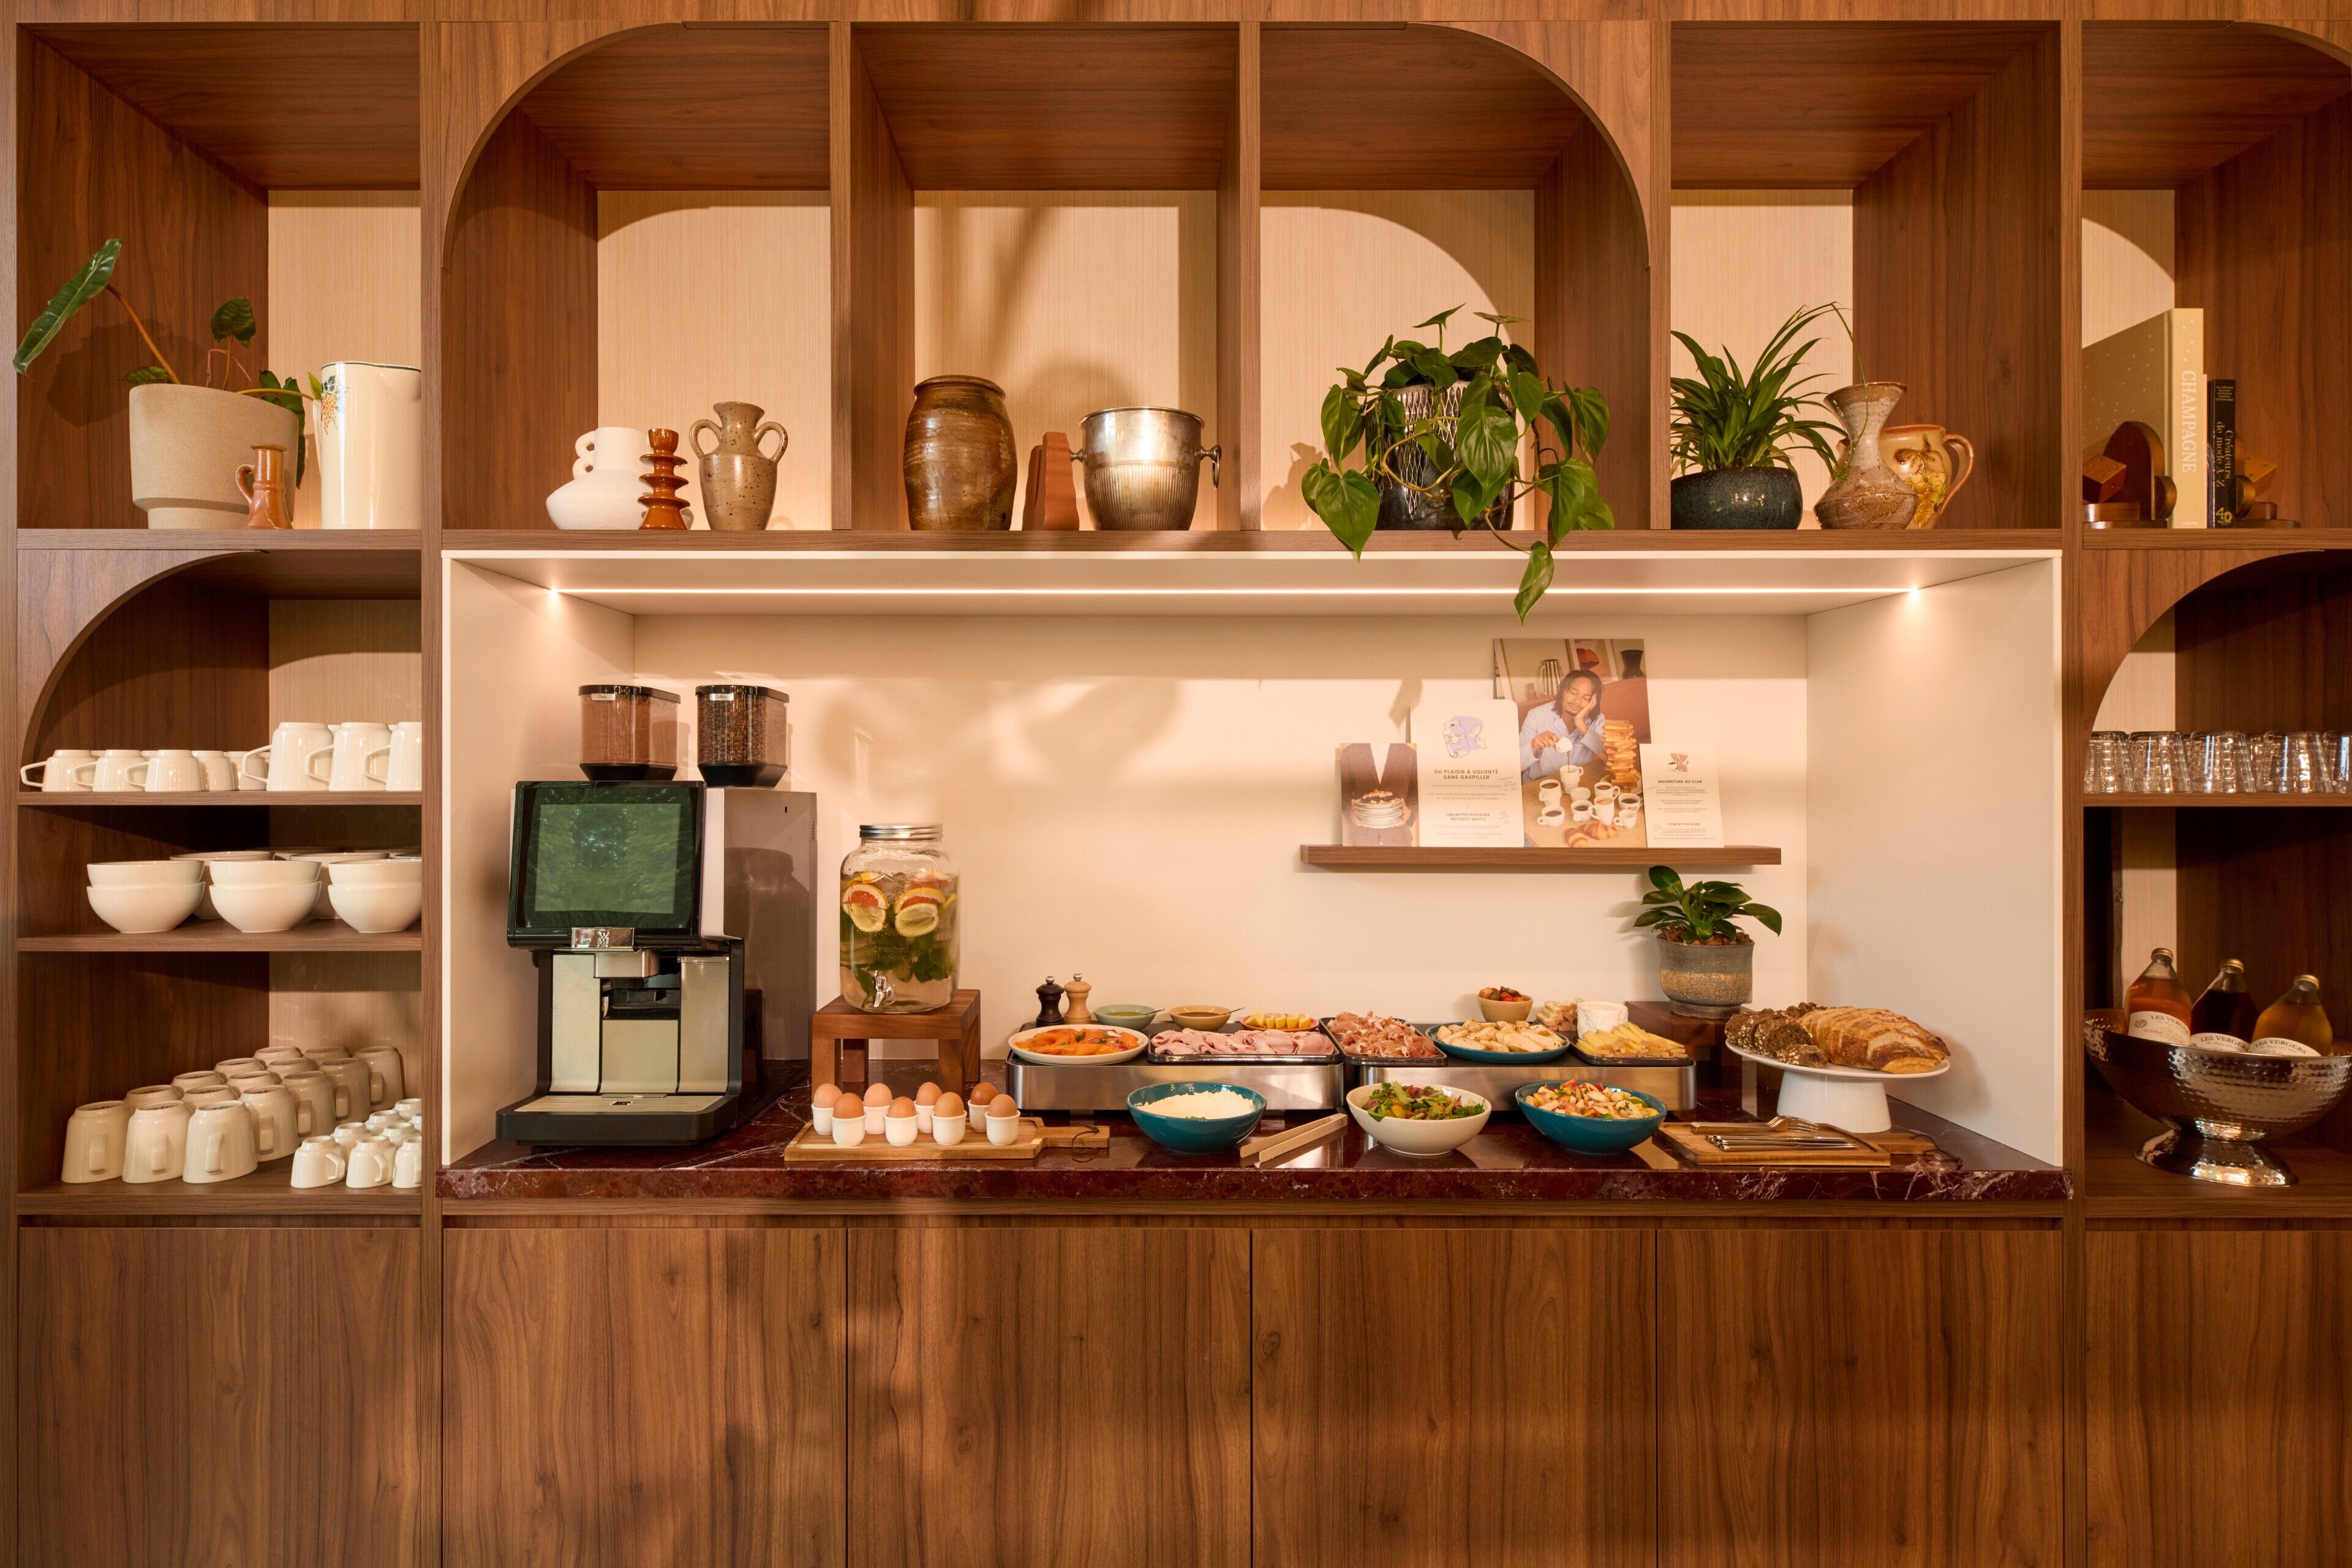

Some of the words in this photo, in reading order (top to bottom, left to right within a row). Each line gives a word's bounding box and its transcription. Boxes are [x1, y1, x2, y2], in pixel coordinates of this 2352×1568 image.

[2181, 370, 2196, 473] CHAMPAGNE
[2216, 421, 2225, 434] de
[2216, 437, 2225, 465] mode
[2225, 429, 2234, 480] Créateurs
[2215, 507, 2233, 521] 40
[2215, 1035, 2250, 1052] VERGERS
[2269, 1039, 2307, 1054] VERGERS
